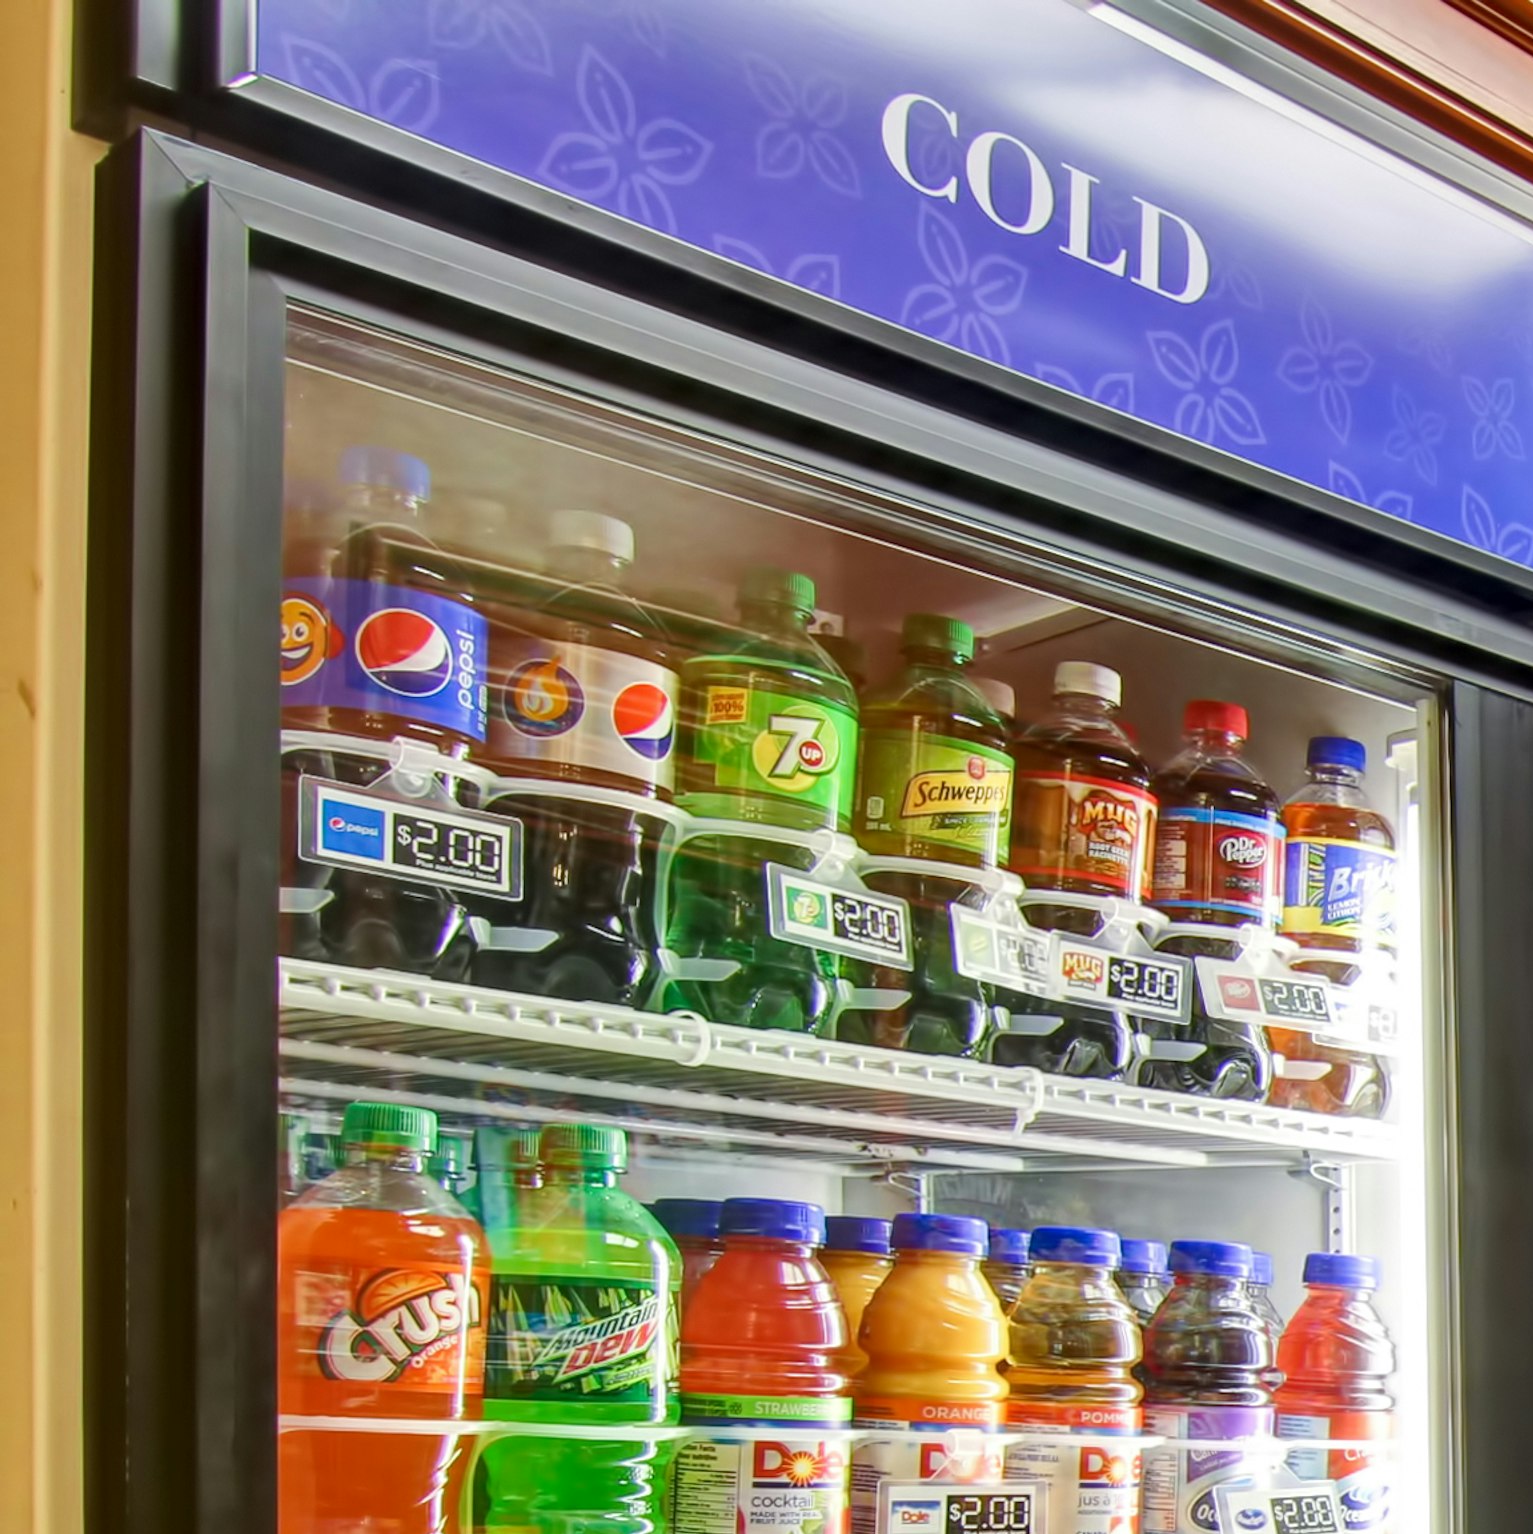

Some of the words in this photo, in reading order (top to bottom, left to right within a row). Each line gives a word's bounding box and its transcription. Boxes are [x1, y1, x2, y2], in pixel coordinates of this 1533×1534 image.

[882, 93, 1210, 304] COLD
[456, 629, 475, 711] pepsi
[711, 701, 745, 714] 100%
[801, 744, 823, 761] UP
[914, 781, 1006, 808] Schweppes
[346, 823, 378, 837] pepsi
[1083, 801, 1138, 838] MUG
[397, 821, 500, 873] $2.00
[1220, 838, 1264, 864] Pepper
[1239, 836, 1256, 851] Dr
[834, 899, 901, 943] $2.00
[1064, 953, 1102, 978] MUG
[1110, 961, 1178, 1002] $2.00
[1263, 982, 1327, 1014] $2.00
[327, 1273, 481, 1382] Crush
[543, 1299, 660, 1358] Mountain
[411, 1334, 458, 1369] orange
[755, 1402, 832, 1417] STRAWBE
[922, 1406, 993, 1420] ORANGE
[1081, 1411, 1130, 1424] POMM
[752, 1441, 843, 1487] Dole
[1079, 1446, 1144, 1487] Doe
[751, 1493, 814, 1509] cocktail
[949, 1497, 1029, 1530] $2.00
[1077, 1494, 1100, 1508] jus
[901, 1511, 930, 1524] Dole
